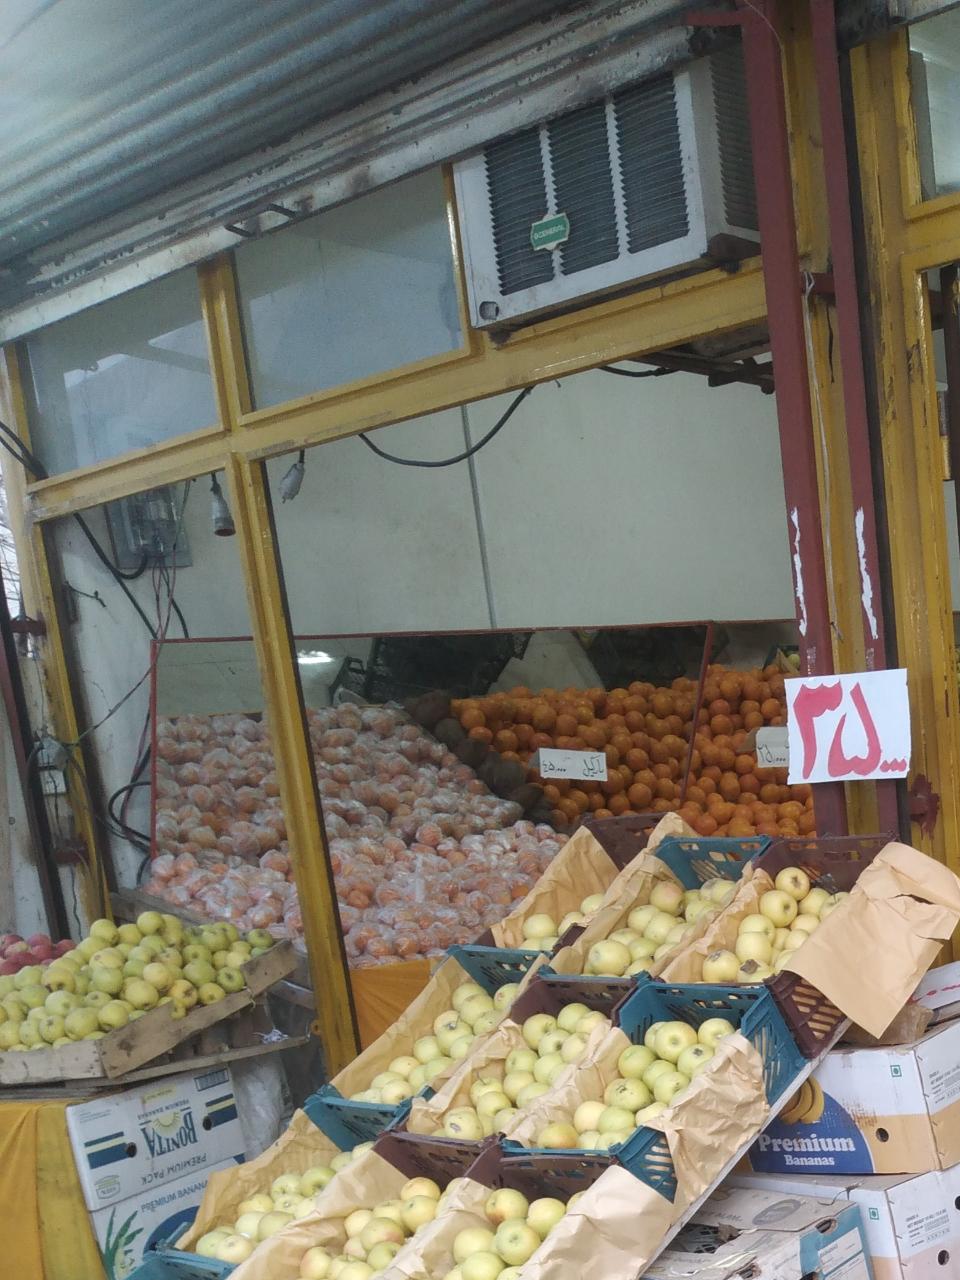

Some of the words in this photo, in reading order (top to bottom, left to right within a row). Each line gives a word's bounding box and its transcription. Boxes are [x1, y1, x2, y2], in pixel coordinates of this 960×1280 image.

[140, 1110, 198, 1159] BONITA
[758, 1130, 856, 1153] Premium
[167, 1152, 207, 1174] PREMIUM
[785, 1154, 835, 1166] Bananas
[141, 1170, 165, 1186] PACK
[141, 1191, 177, 1212] PREMIUM
